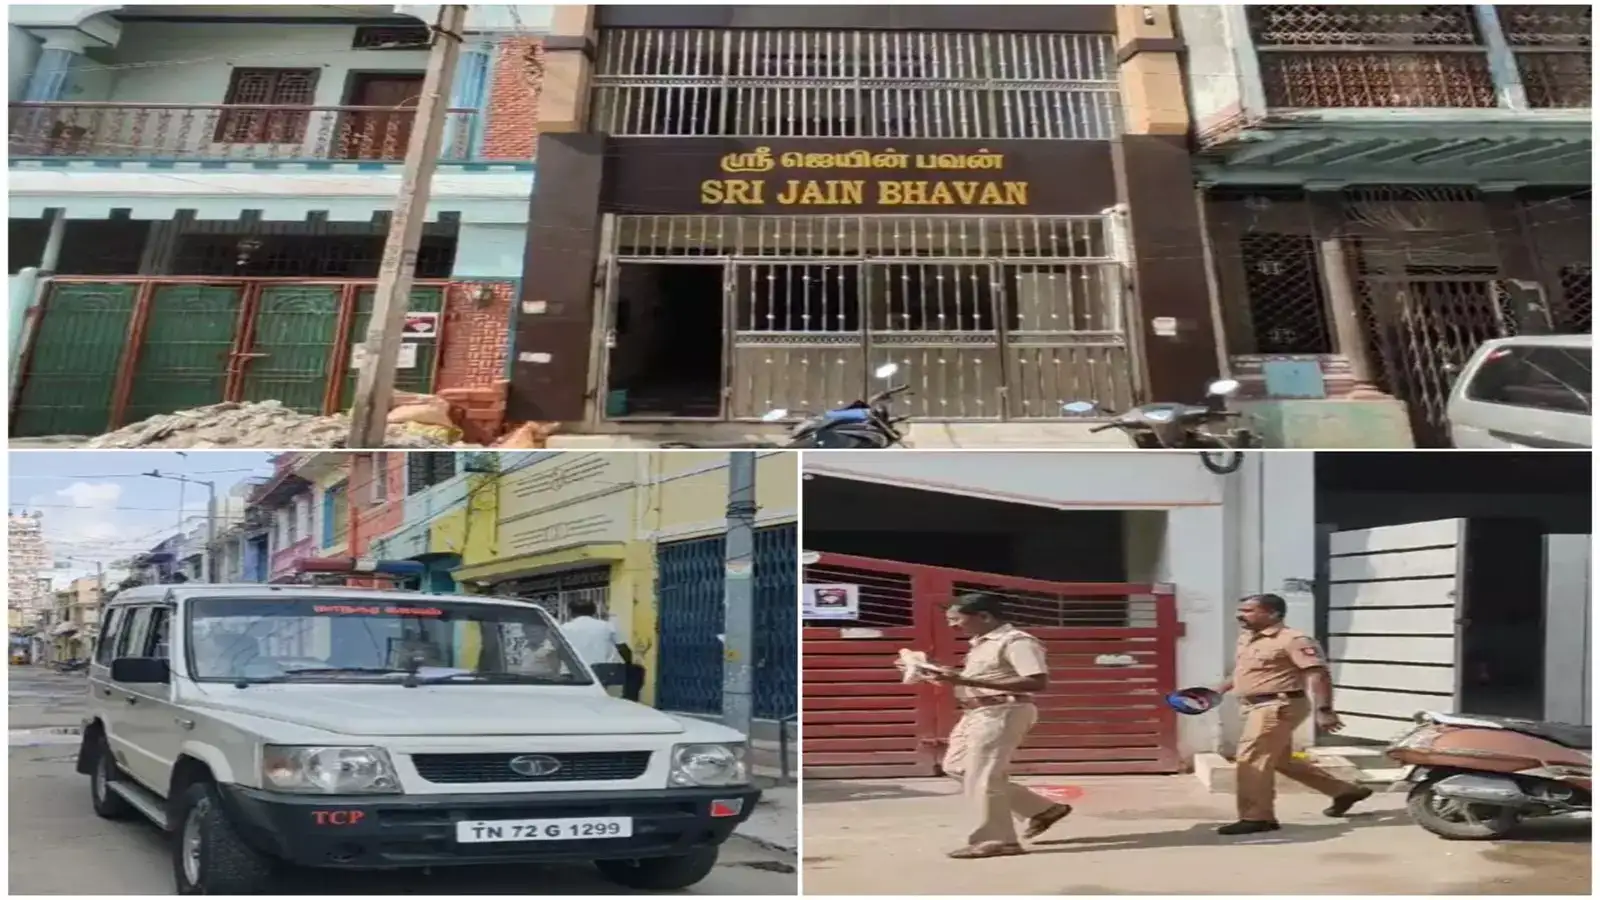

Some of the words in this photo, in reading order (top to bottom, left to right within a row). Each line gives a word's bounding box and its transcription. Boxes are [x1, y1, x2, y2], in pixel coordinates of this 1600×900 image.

[781, 149, 909, 169] ஜெயின்
[916, 149, 1003, 169] பவன்
[701, 179, 765, 205] SRI
[777, 180, 865, 205] JAIN
[878, 180, 1028, 205] BHAVAN
[312, 811, 365, 825] TCP
[472, 825, 504, 840] TN
[511, 824, 538, 838] 72
[545, 824, 561, 837] G
[571, 822, 621, 837] 1299
